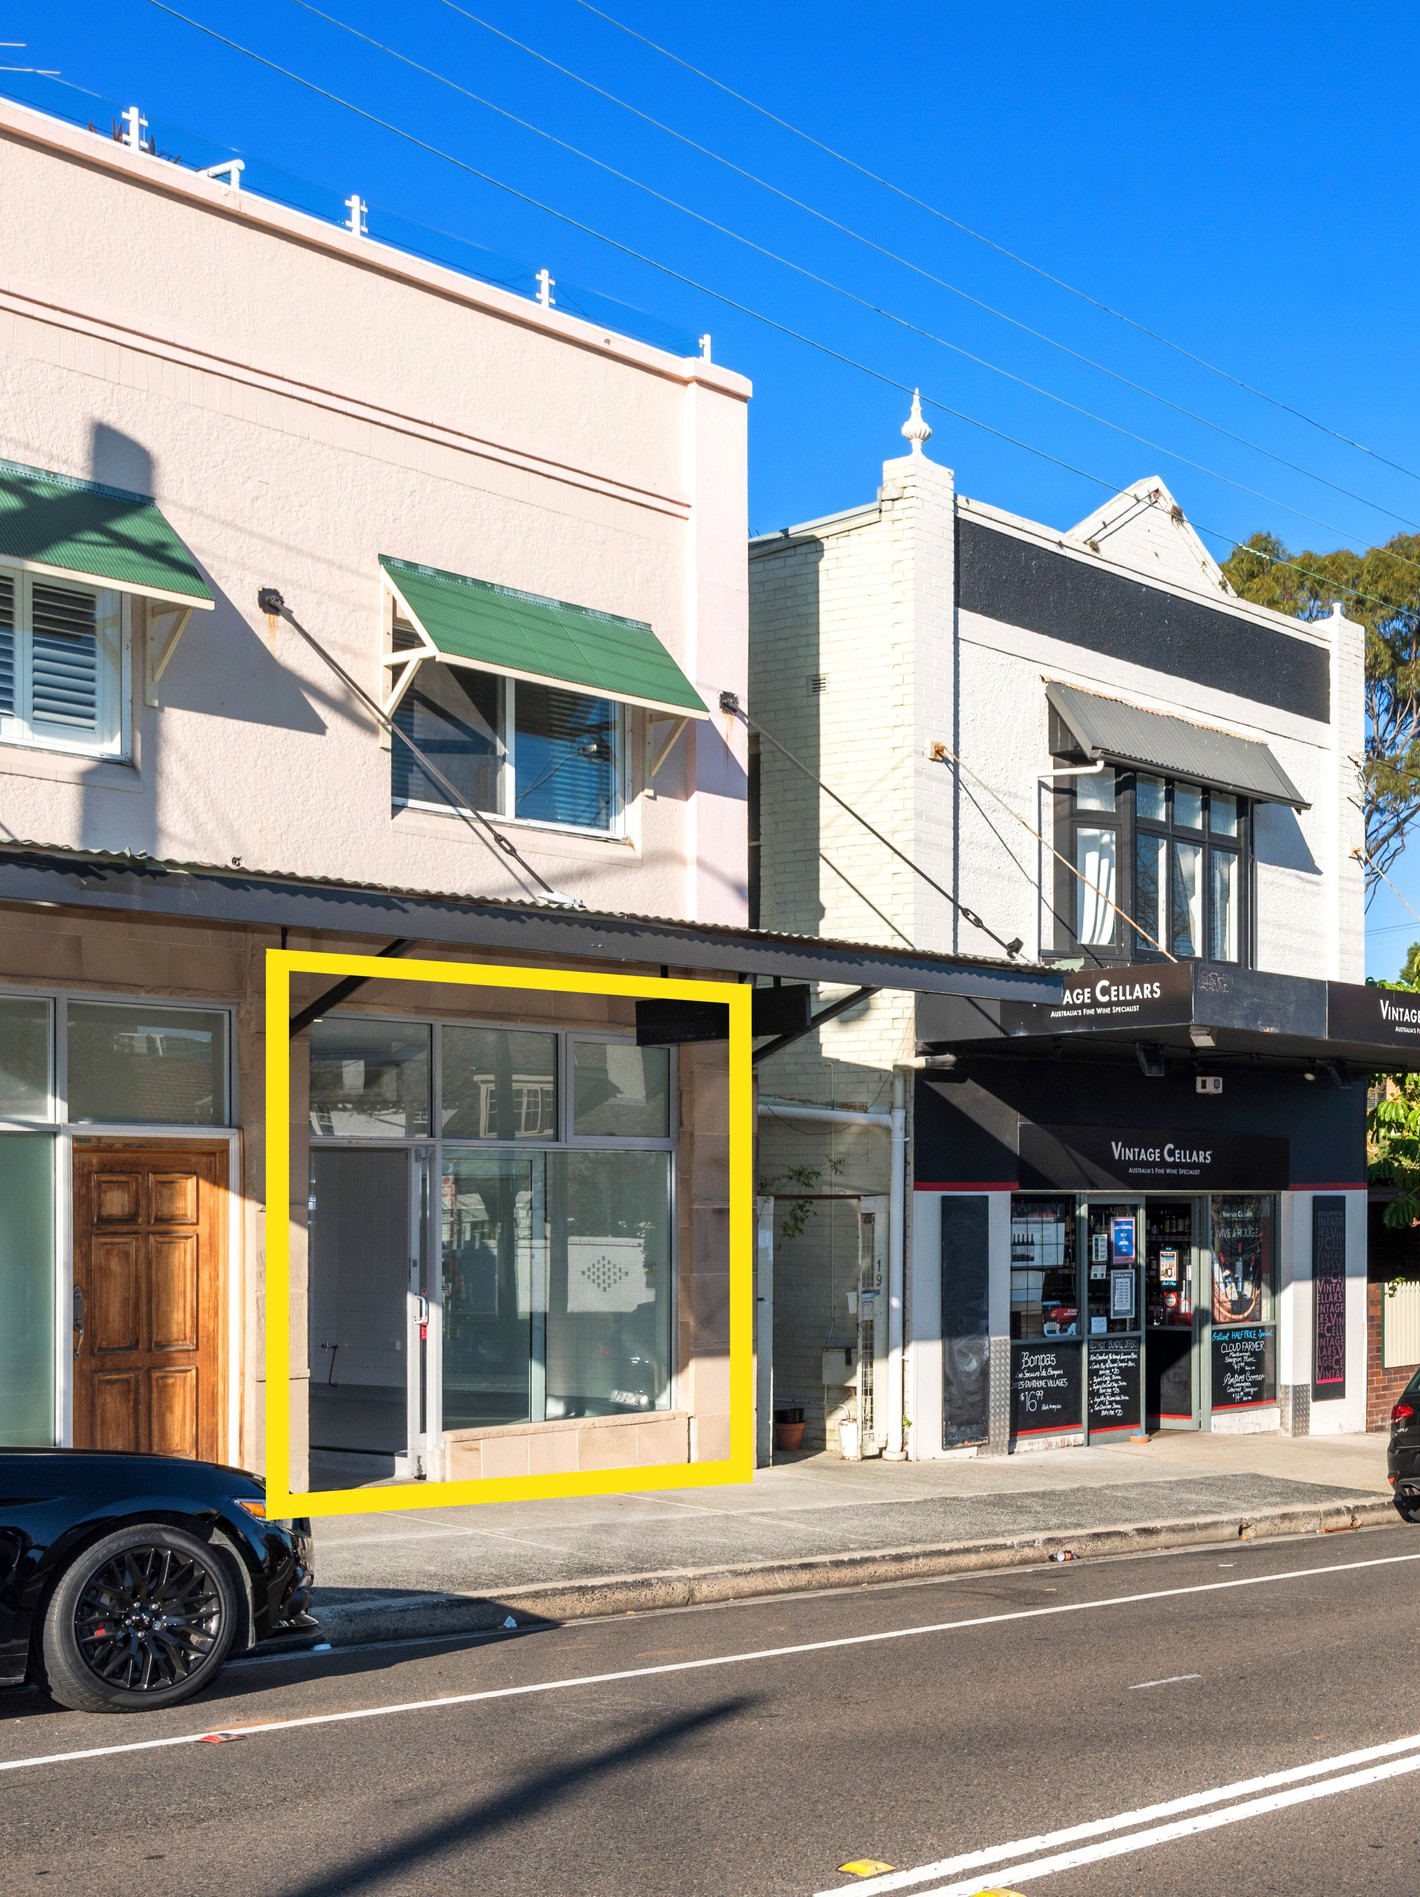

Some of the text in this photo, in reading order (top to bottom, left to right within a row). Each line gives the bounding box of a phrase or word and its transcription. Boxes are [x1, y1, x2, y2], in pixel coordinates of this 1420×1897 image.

[1095, 980, 1161, 1002] CELLARS
[1051, 1008, 1082, 1018] AUSTRALIA'S
[1083, 1008, 1095, 1016] FINE
[1112, 1005, 1140, 1013] SPECIALIST
[1111, 1141, 1211, 1163] VINTAGE CELLARS
